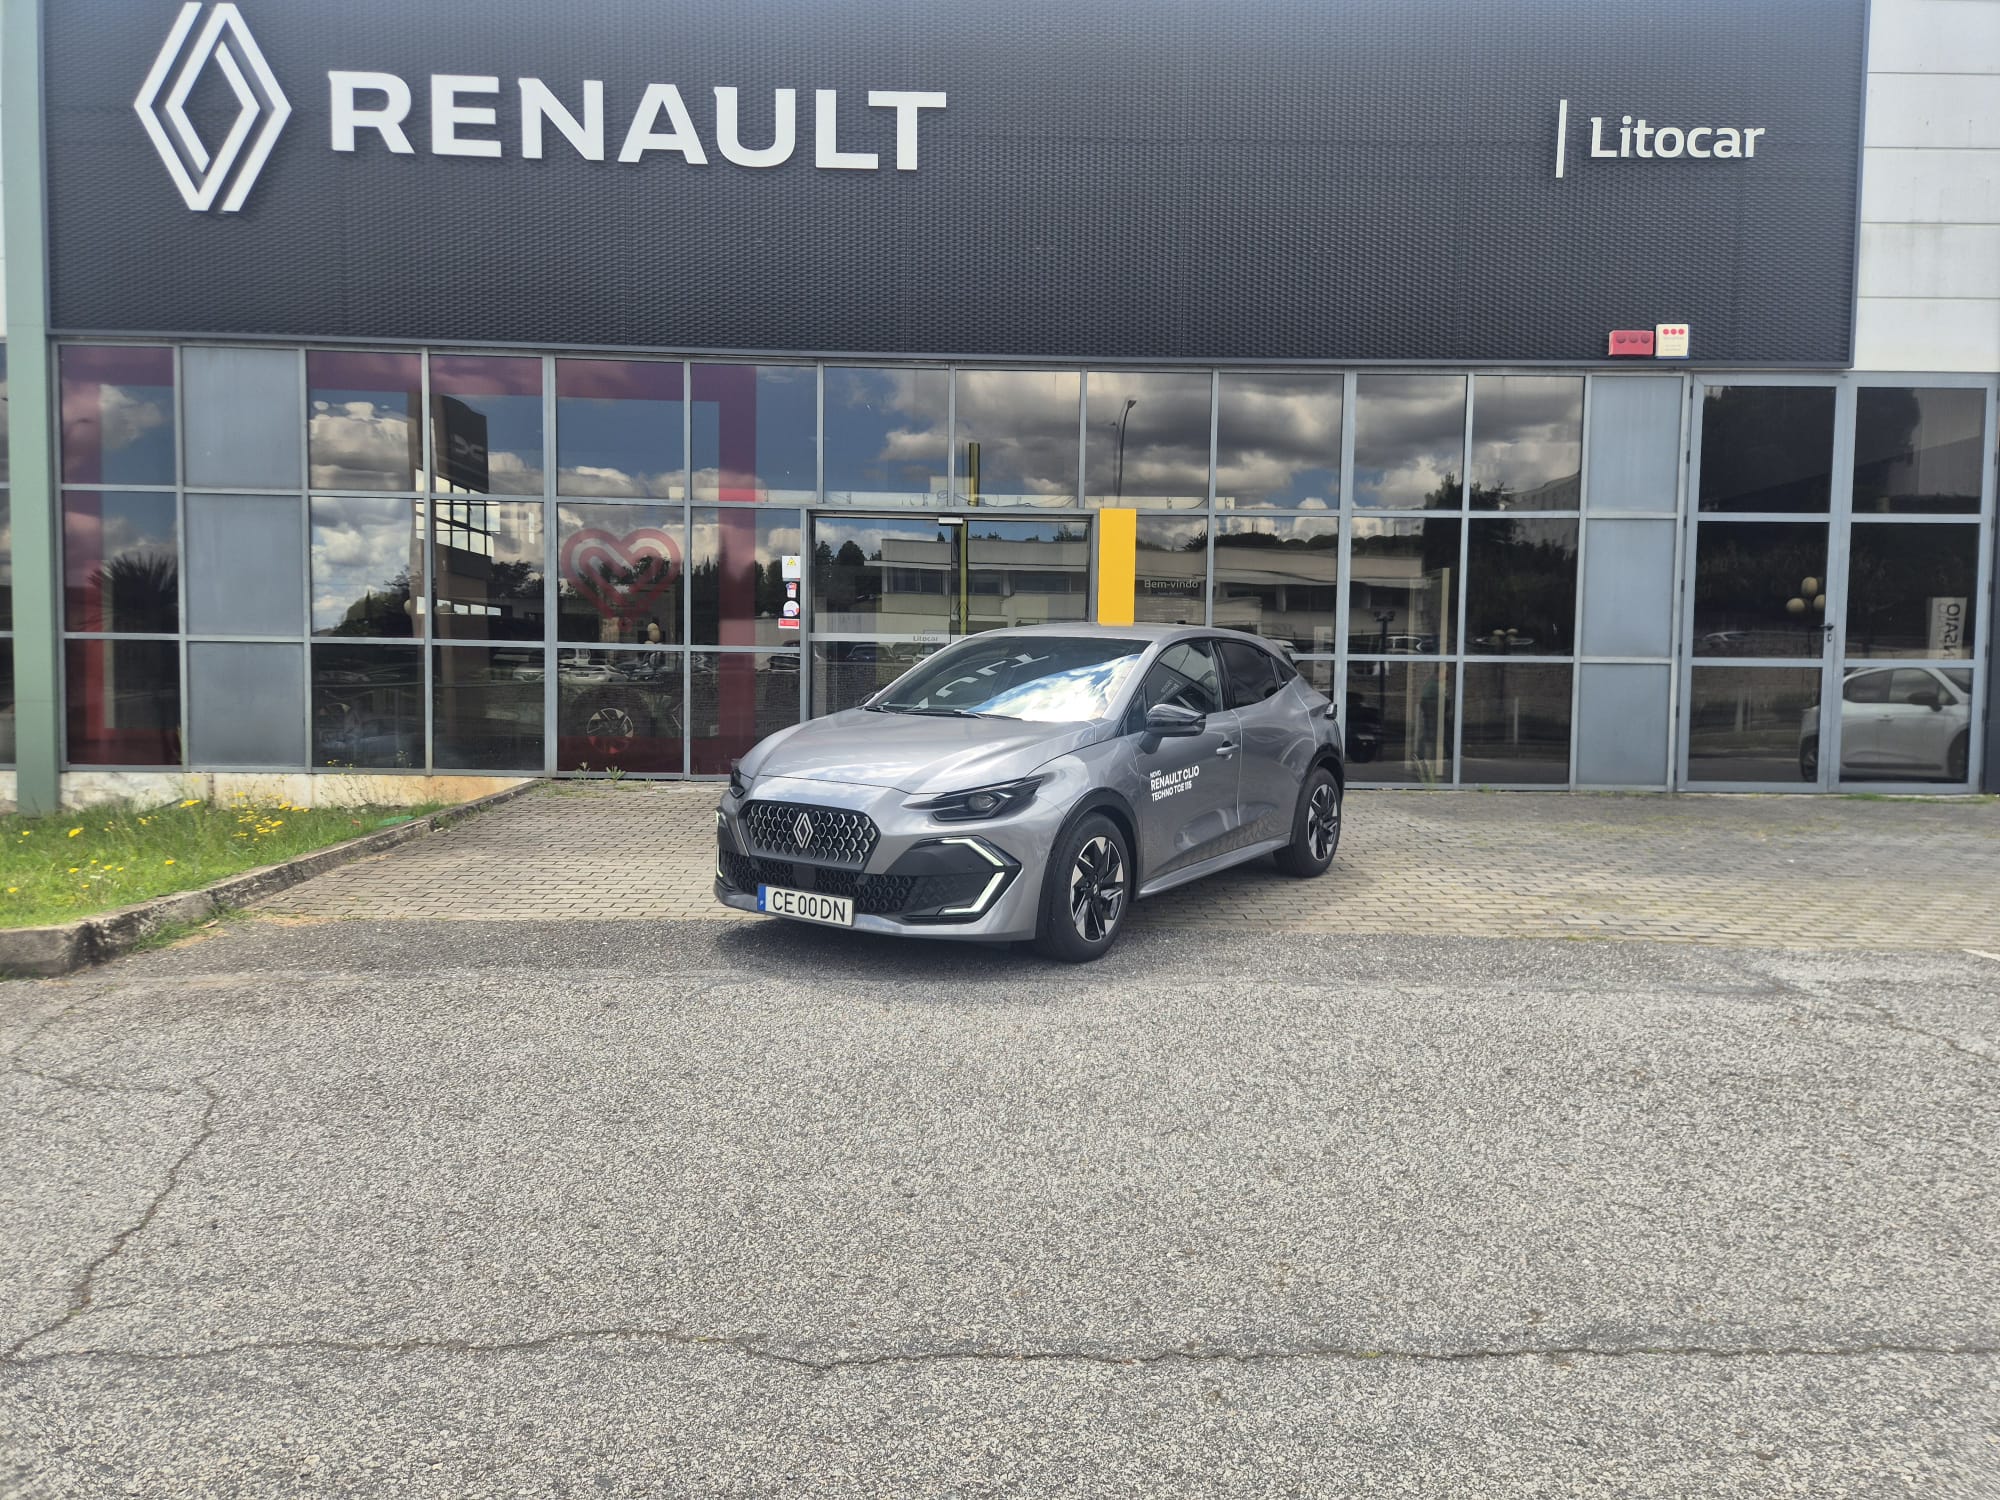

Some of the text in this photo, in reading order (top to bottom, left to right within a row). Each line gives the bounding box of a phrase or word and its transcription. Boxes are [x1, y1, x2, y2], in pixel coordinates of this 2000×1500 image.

[328, 70, 947, 171] RENAULT
[1590, 115, 1766, 158] Litocar
[1144, 579, 1199, 589] Bem-vindo
[1150, 765, 1200, 791] RENAULT CLIO
[1151, 787, 1174, 802] TECHNO
